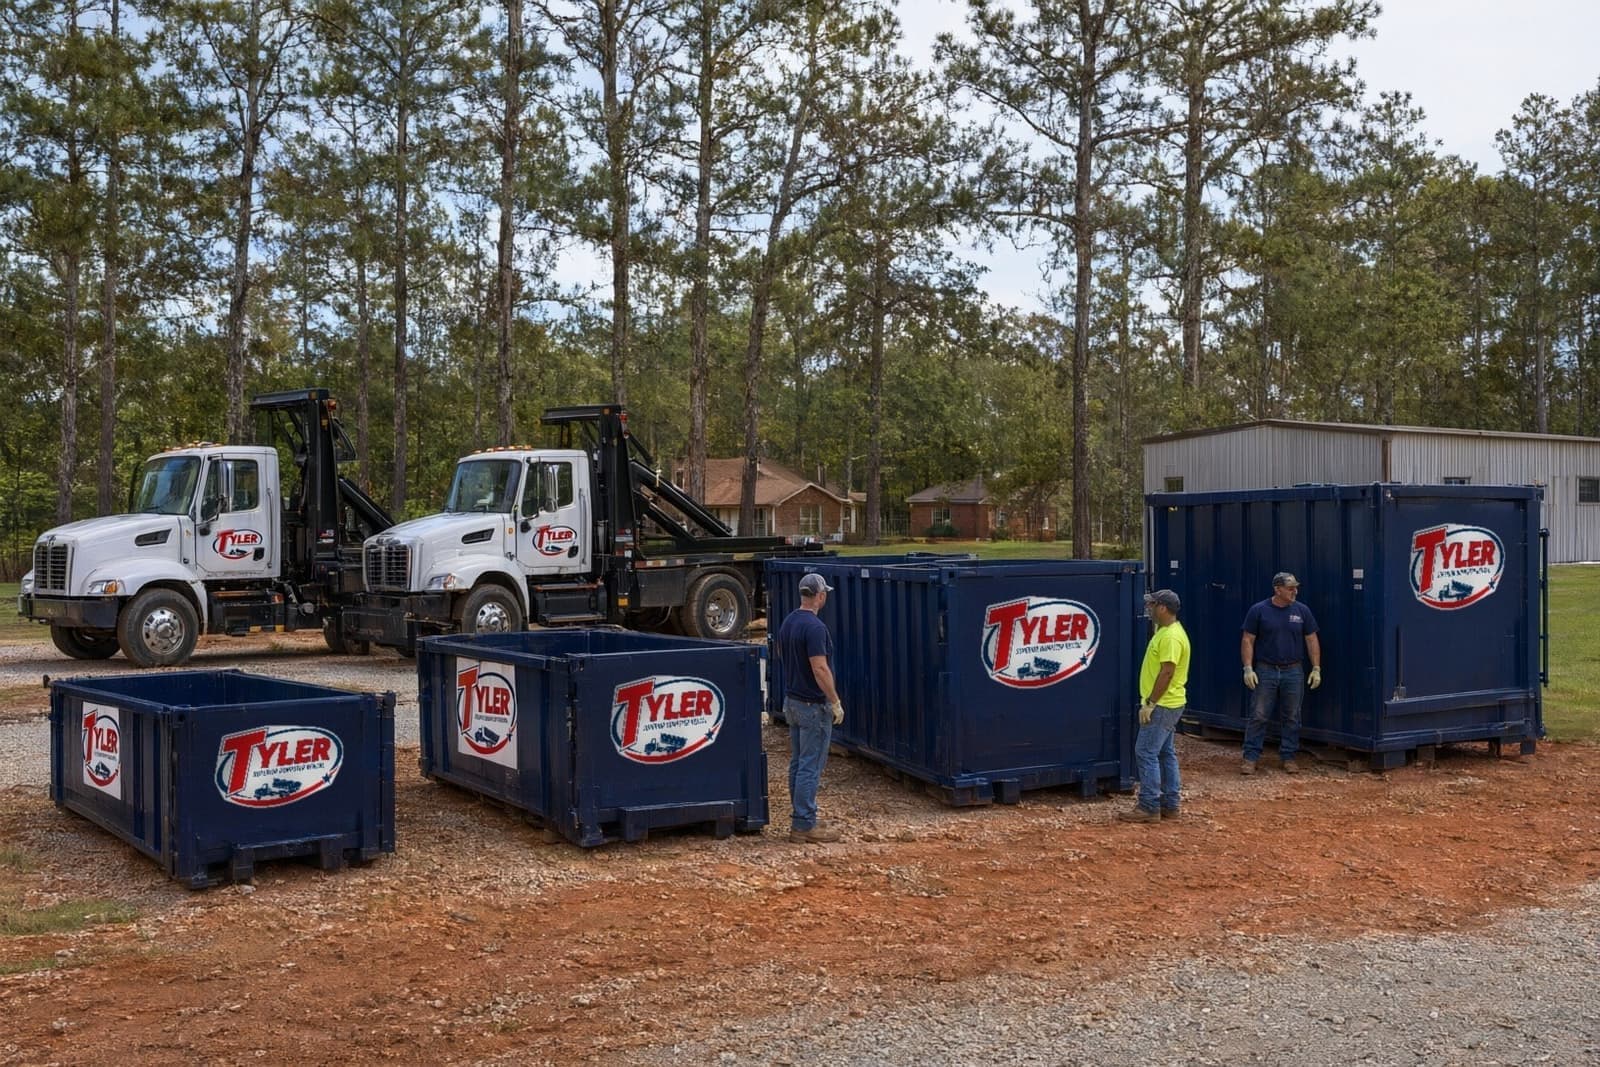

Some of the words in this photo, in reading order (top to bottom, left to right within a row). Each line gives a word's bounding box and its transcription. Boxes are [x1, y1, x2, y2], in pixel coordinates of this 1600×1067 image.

[217, 530, 258, 553] TYLER
[1414, 527, 1495, 593] TYLER
[987, 600, 1089, 672] TYLER
[458, 667, 510, 731] TYLER
[616, 680, 713, 749] TYLER
[84, 711, 117, 764] TYLER
[223, 729, 331, 794] TYLER
